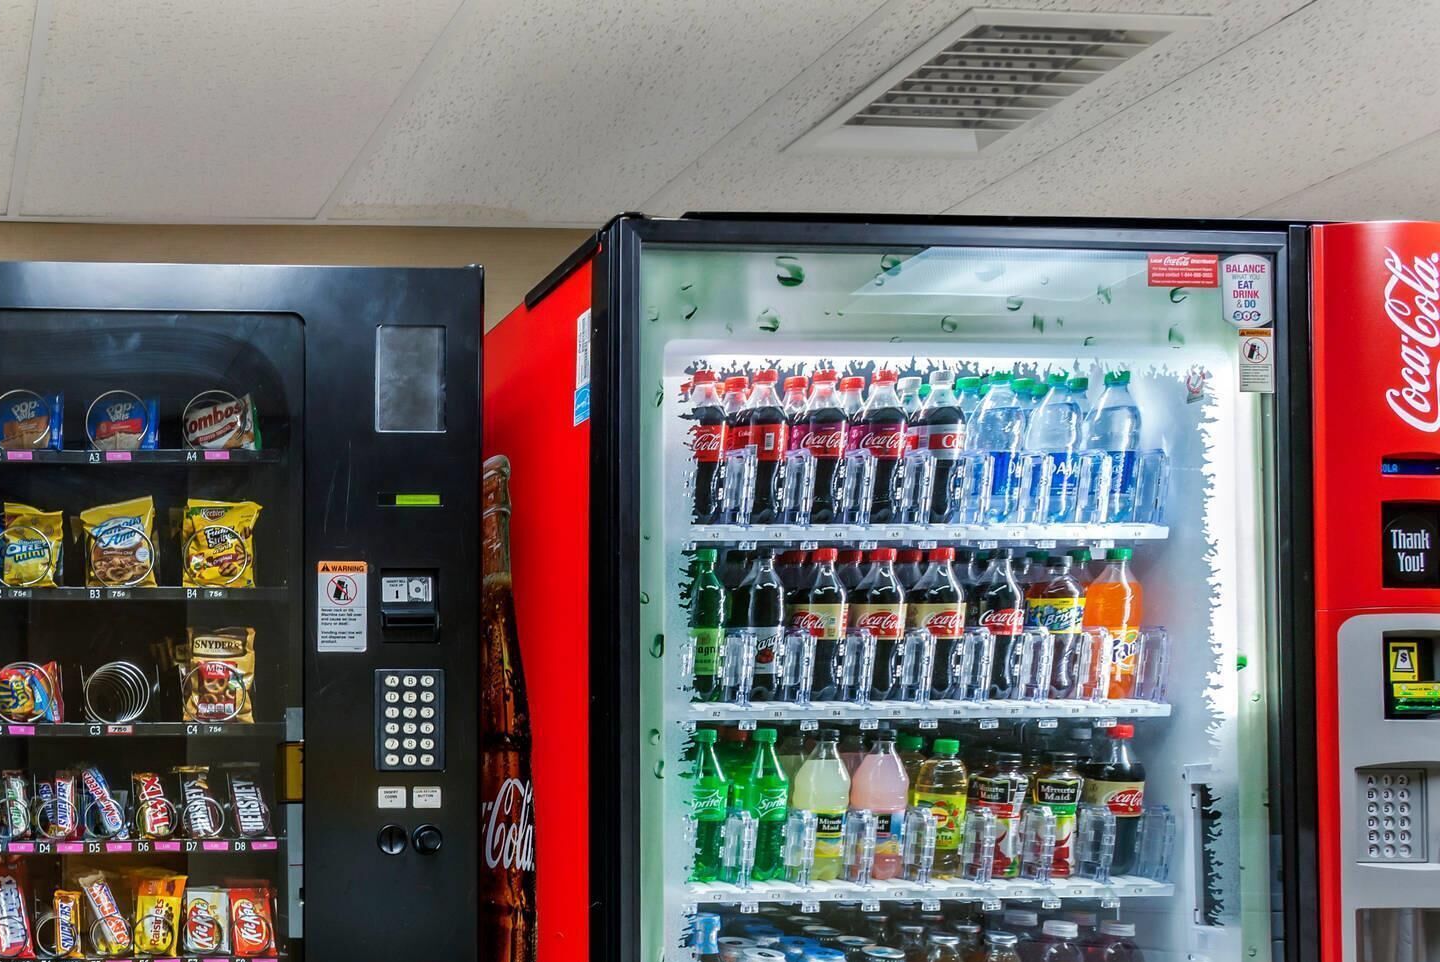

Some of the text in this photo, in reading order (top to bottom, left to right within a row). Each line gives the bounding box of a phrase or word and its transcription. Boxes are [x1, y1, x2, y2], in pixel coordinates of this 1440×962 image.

[1226, 264, 1266, 273] BALANCE
[1237, 280, 1254, 290] EAT
[1233, 290, 1260, 299] DRINK
[1237, 300, 1256, 308] & DO
[89, 452, 100, 462] A3
[186, 451, 197, 461] A4
[1390, 528, 1430, 550] Thank
[1397, 552, 1425, 573] You!
[13, 590, 27, 598] 75¢
[89, 589, 126, 599] B3 75¢
[186, 589, 223, 598] B4 75¢
[89, 725, 101, 735] C3
[186, 725, 198, 734] C4
[1367, 776, 1374, 785] A
[1041, 785, 1076, 795] Minute
[1367, 791, 1374, 799] B
[1045, 792, 1070, 801] Maid
[57, 781, 70, 828] SNICKERS
[1367, 804, 1374, 813] C
[1367, 818, 1374, 827] D
[1367, 832, 1374, 841] E
[39, 843, 50, 853] D4
[89, 842, 100, 853] D5
[138, 842, 149, 852] D6
[186, 841, 198, 851] D7
[234, 841, 246, 851] D8
[1367, 846, 1374, 855] F
[60, 903, 73, 950] SNICKERS
[150, 898, 164, 946] Raisinets
